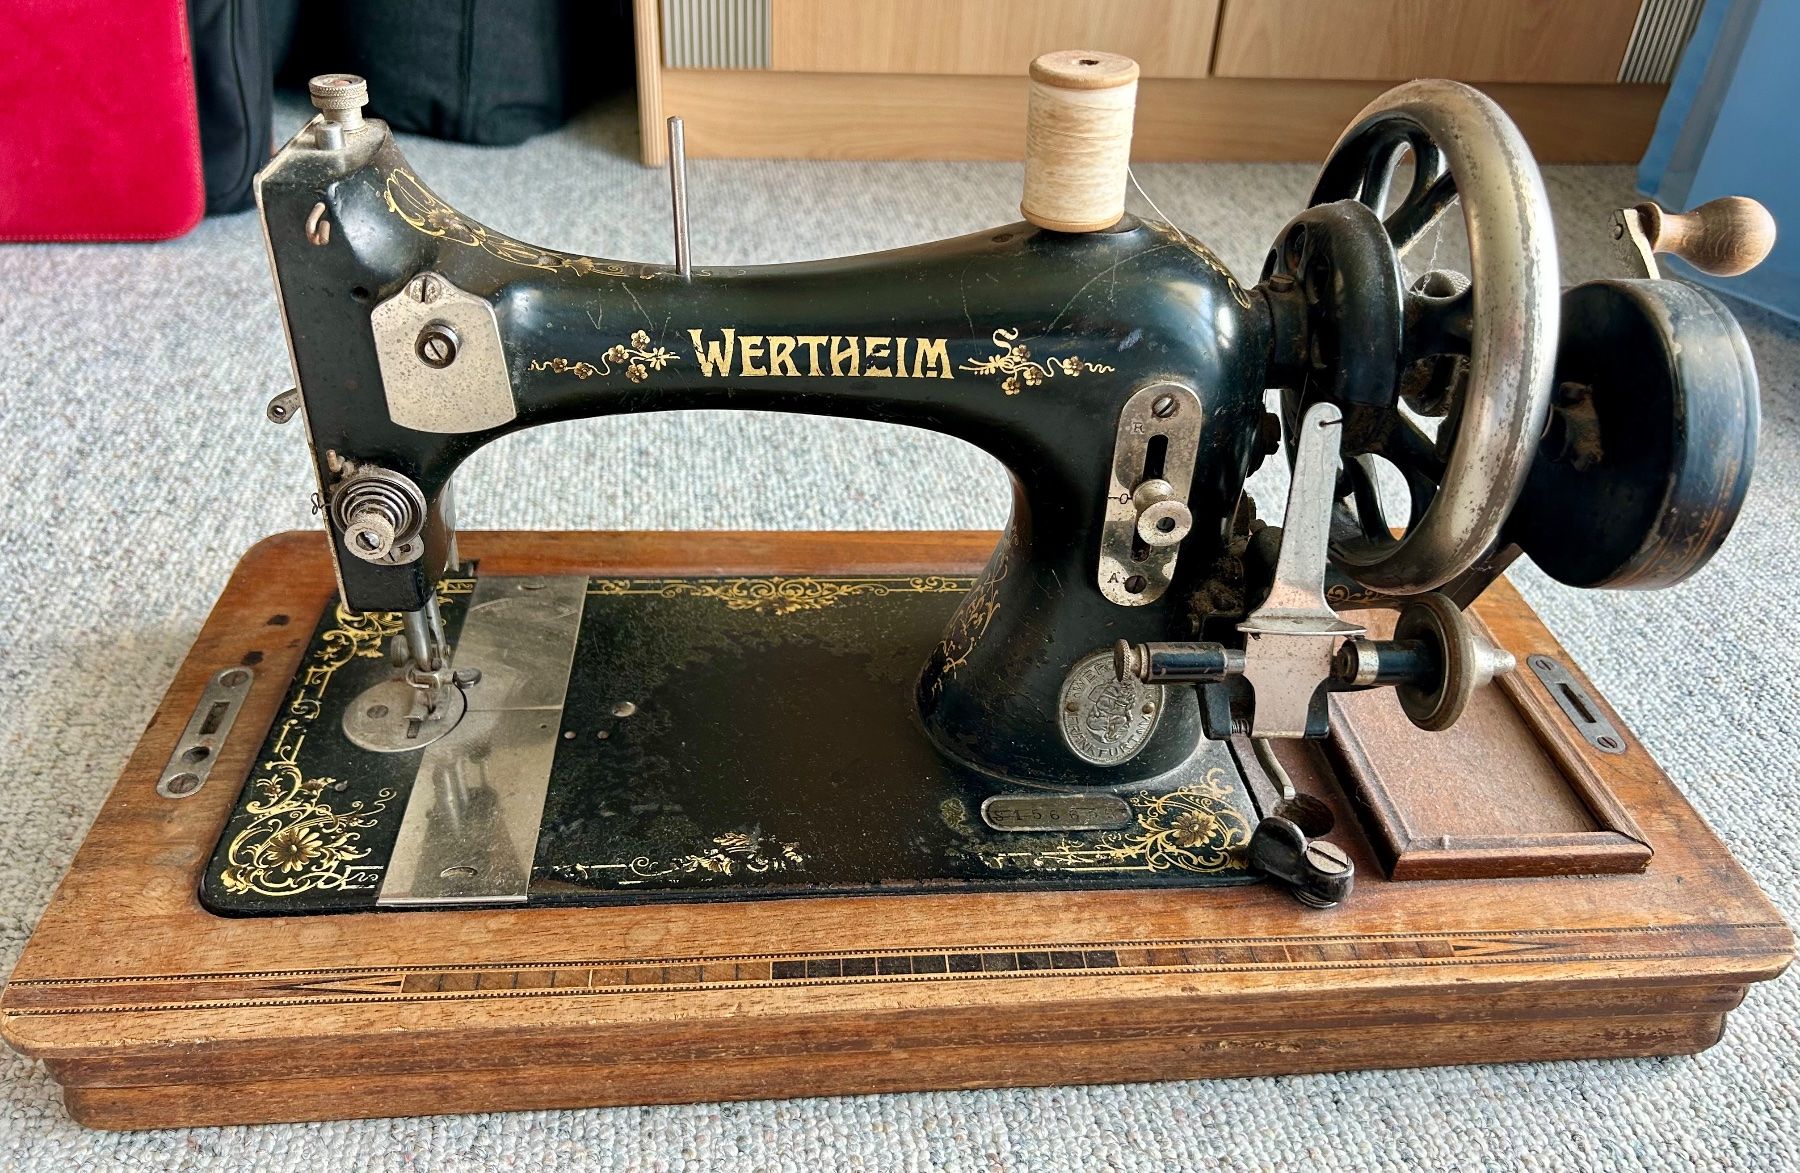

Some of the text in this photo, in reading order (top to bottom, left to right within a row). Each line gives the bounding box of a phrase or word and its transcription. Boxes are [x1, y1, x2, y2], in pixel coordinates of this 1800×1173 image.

[687, 328, 955, 379] WERTHEIM
[1133, 421, 1145, 434] R
[1107, 572, 1119, 584] A
